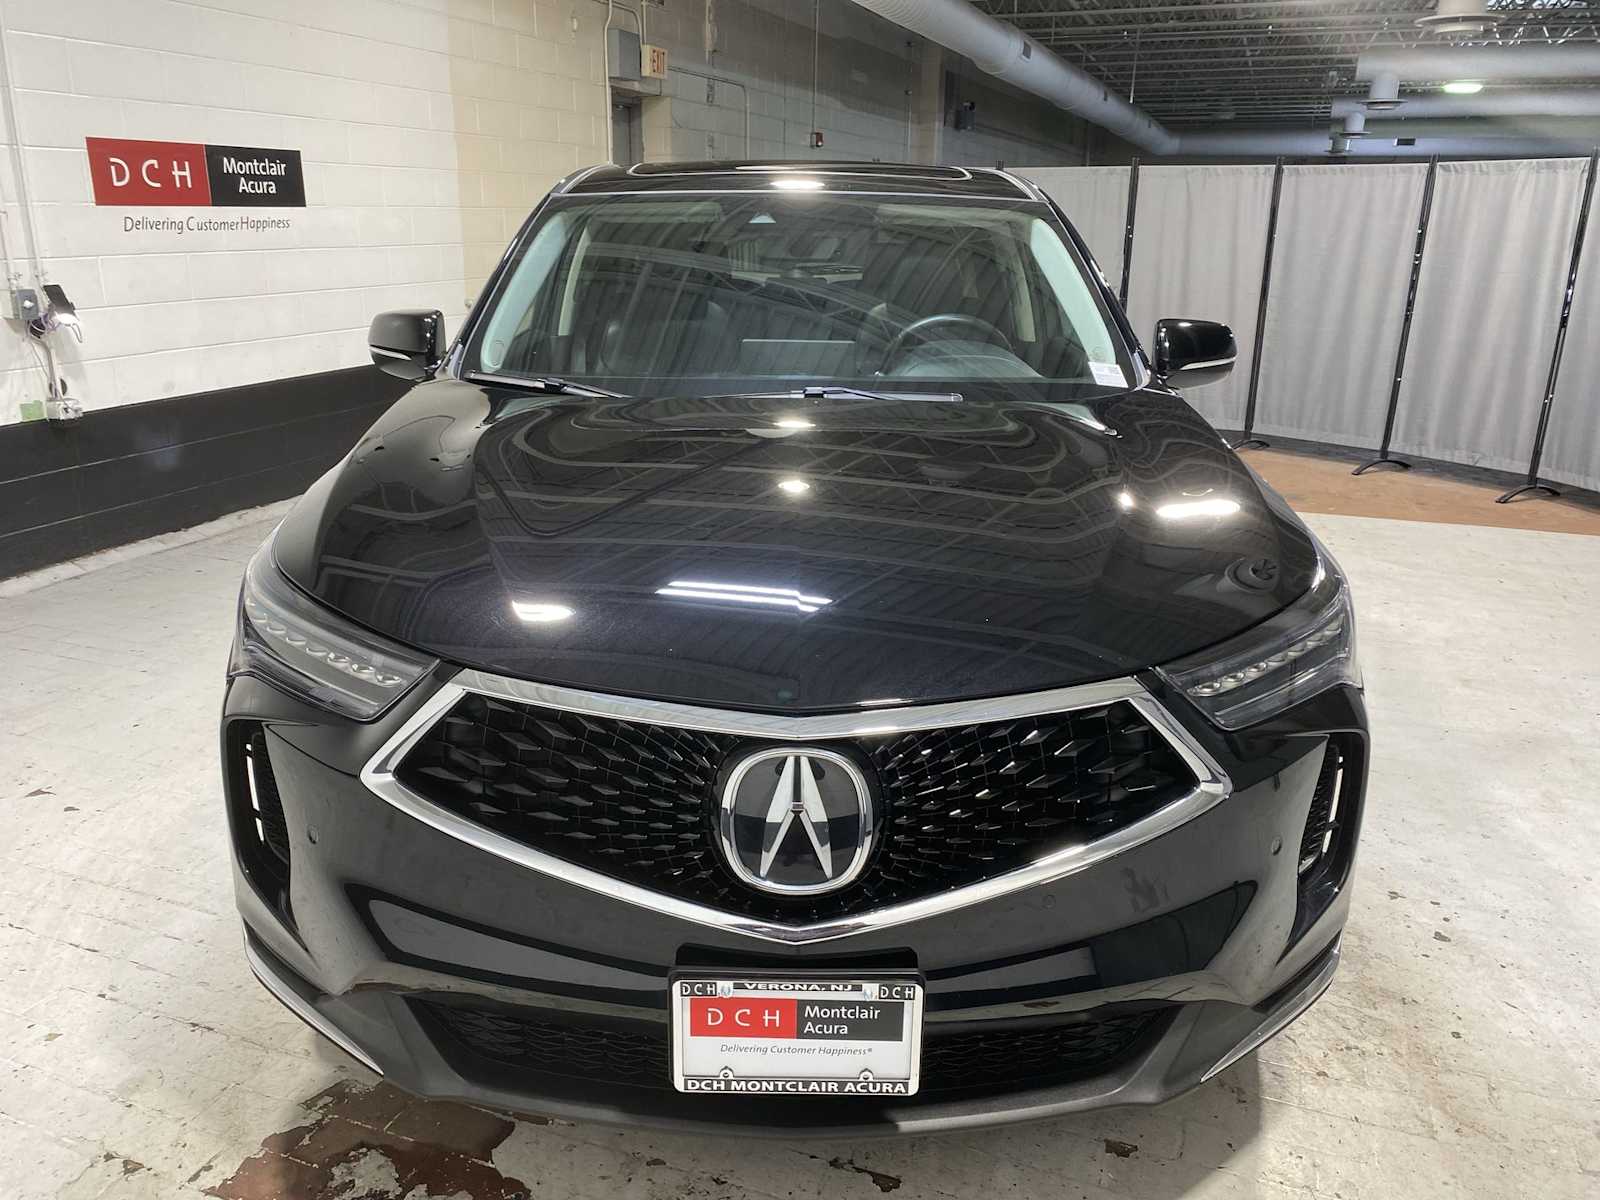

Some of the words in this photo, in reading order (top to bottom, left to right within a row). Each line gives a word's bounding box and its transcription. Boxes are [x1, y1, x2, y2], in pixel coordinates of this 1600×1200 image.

[223, 157, 286, 176] Montclair
[238, 177, 277, 194] Acura
[124, 216, 184, 234] Delivering
[186, 216, 239, 232] Customer
[240, 217, 291, 232] Happiness
[681, 983, 716, 996] DCH
[744, 983, 826, 992] VERONA,
[829, 984, 852, 992] NJ
[880, 986, 914, 999] DCH
[804, 1005, 880, 1020] Montclair
[803, 1021, 849, 1035] Acura
[720, 1044, 768, 1055] Delivering
[770, 1045, 816, 1055] Customer
[687, 1079, 725, 1092] DCH
[730, 1080, 839, 1093] MONTCLAIR
[844, 1082, 906, 1095] ACURA
